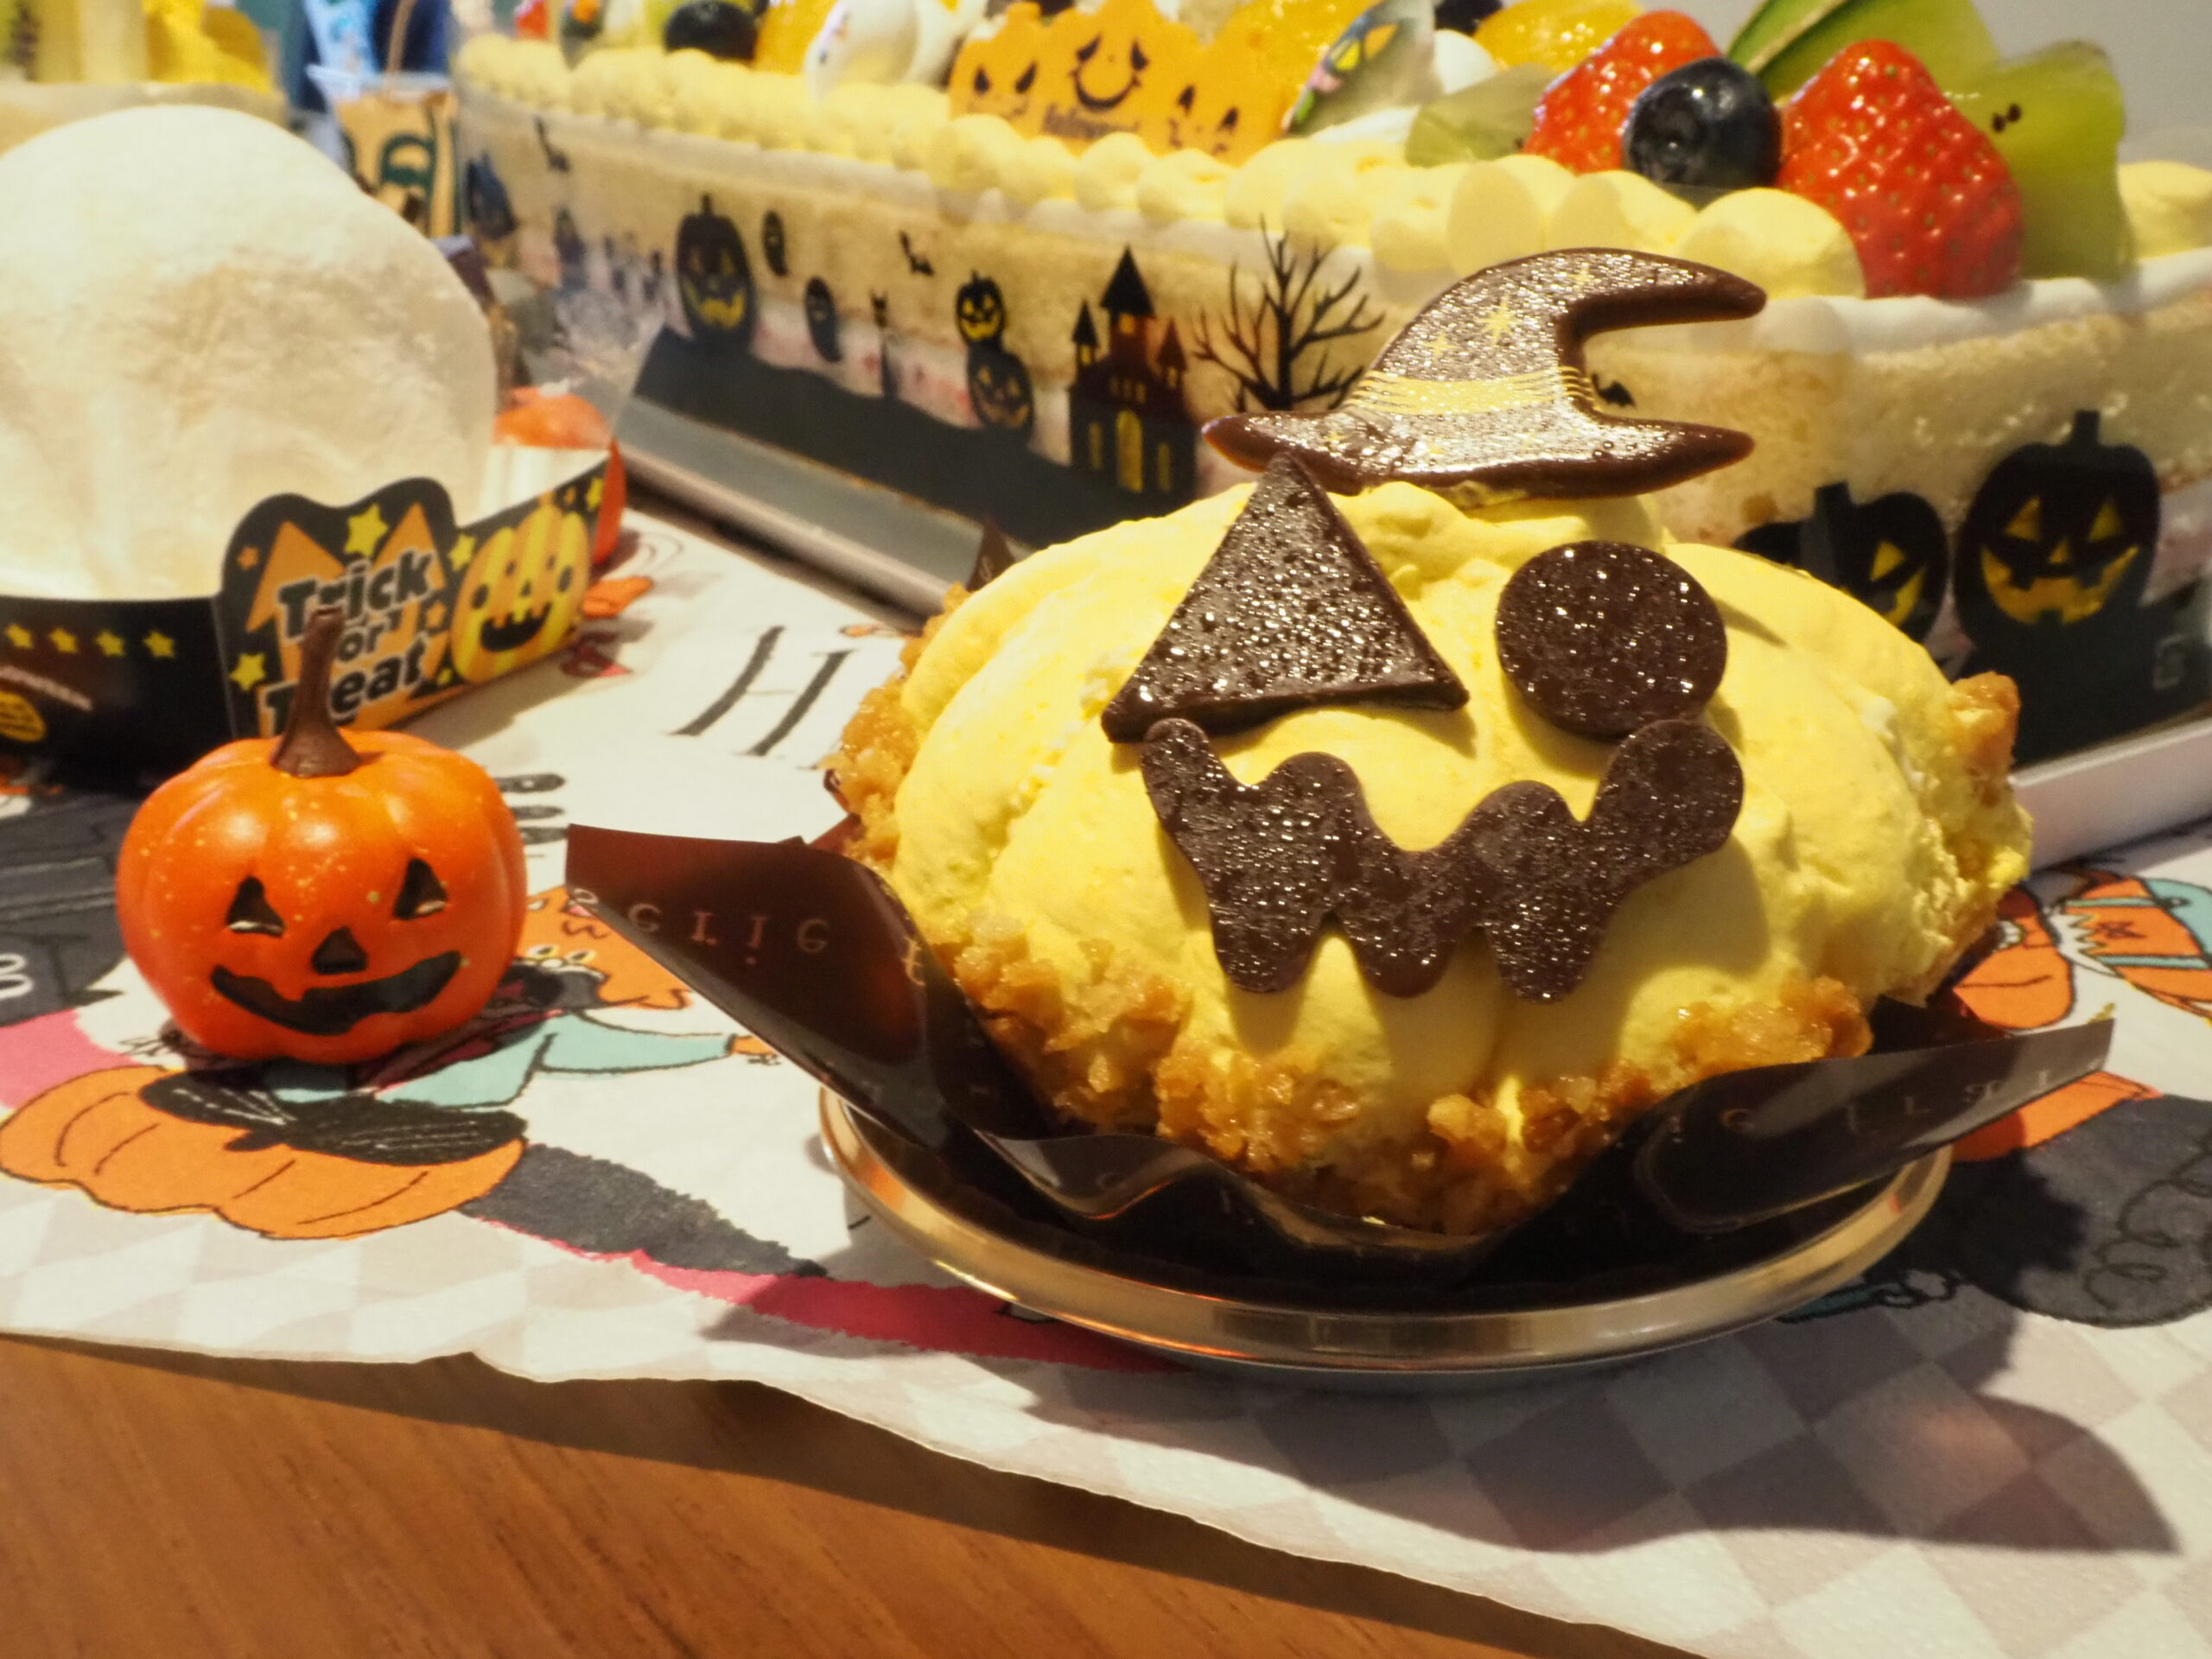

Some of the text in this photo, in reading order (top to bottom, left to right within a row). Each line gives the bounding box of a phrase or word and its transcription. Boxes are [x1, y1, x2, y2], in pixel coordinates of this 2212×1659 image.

[276, 549, 434, 641] Trick
[265, 633, 428, 736] Teat
[337, 623, 388, 664] or
